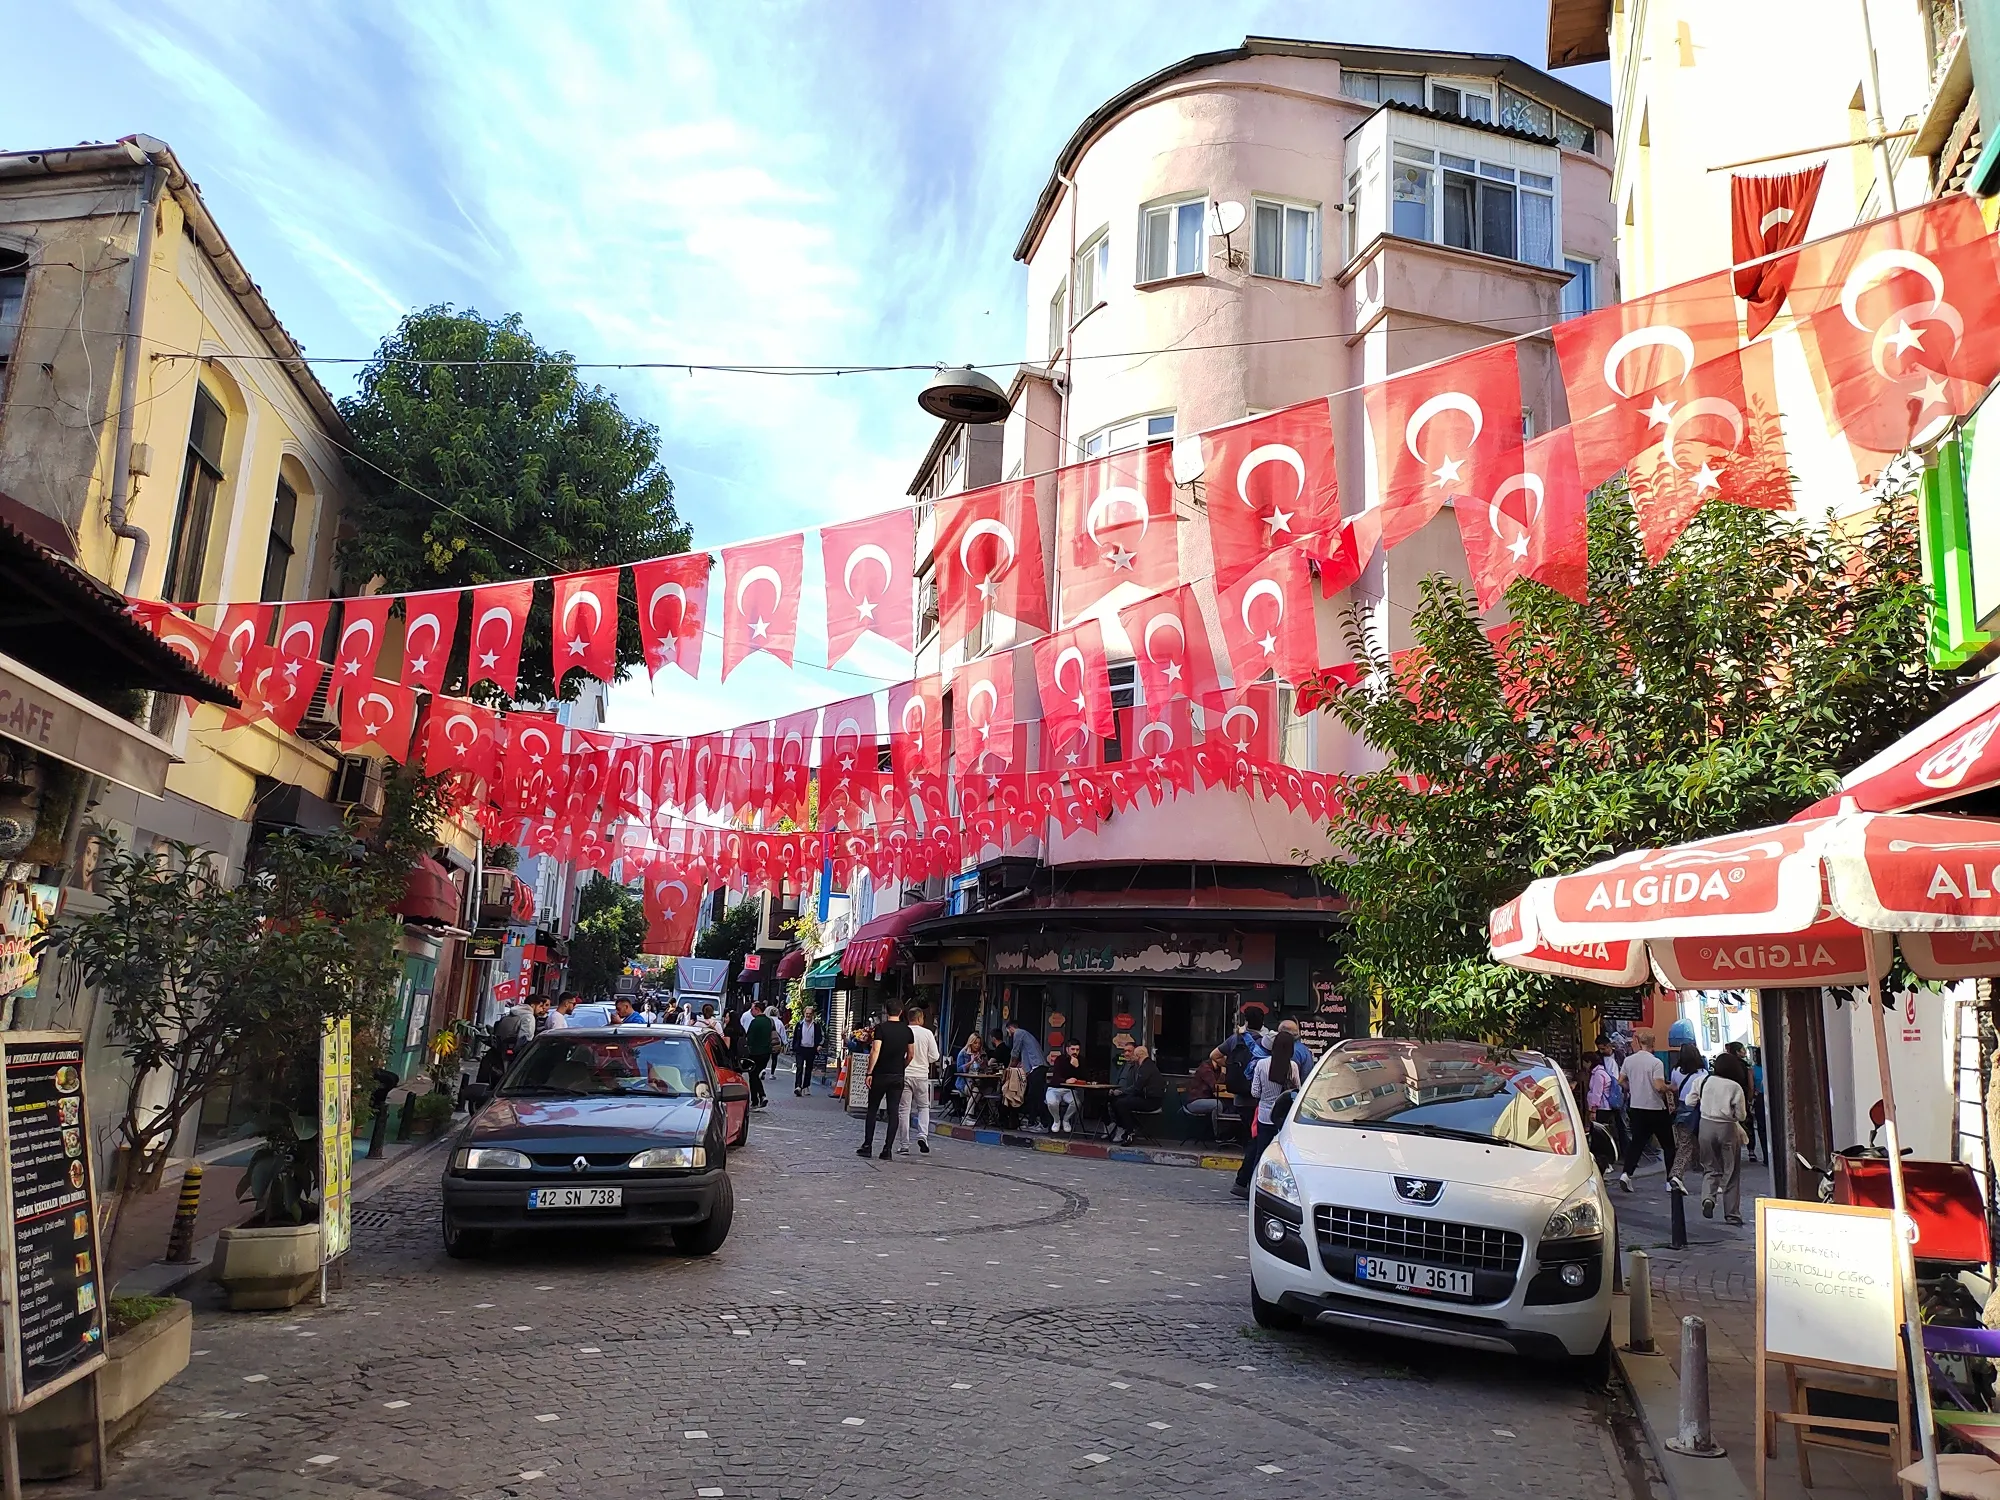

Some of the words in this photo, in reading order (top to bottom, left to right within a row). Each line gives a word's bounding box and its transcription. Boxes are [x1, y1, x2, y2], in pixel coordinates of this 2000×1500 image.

[0, 689, 54, 745] CAFE
[539, 1191, 556, 1206] 42
[564, 1190, 582, 1205] SN
[590, 1189, 615, 1204] 738
[16, 1204, 34, 1218] SOĞUK
[18, 1229, 31, 1240] Soğuk
[18, 1244, 33, 1254] Frappe
[1358, 1267, 1367, 1275] TR
[1368, 1259, 1388, 1280] 34
[1396, 1263, 1417, 1284] DV
[1426, 1268, 1467, 1292] 3611
[20, 1287, 33, 1298] Ayran
[1771, 1274, 1801, 1288] TEA
[1814, 1282, 1867, 1300] COFFEE
